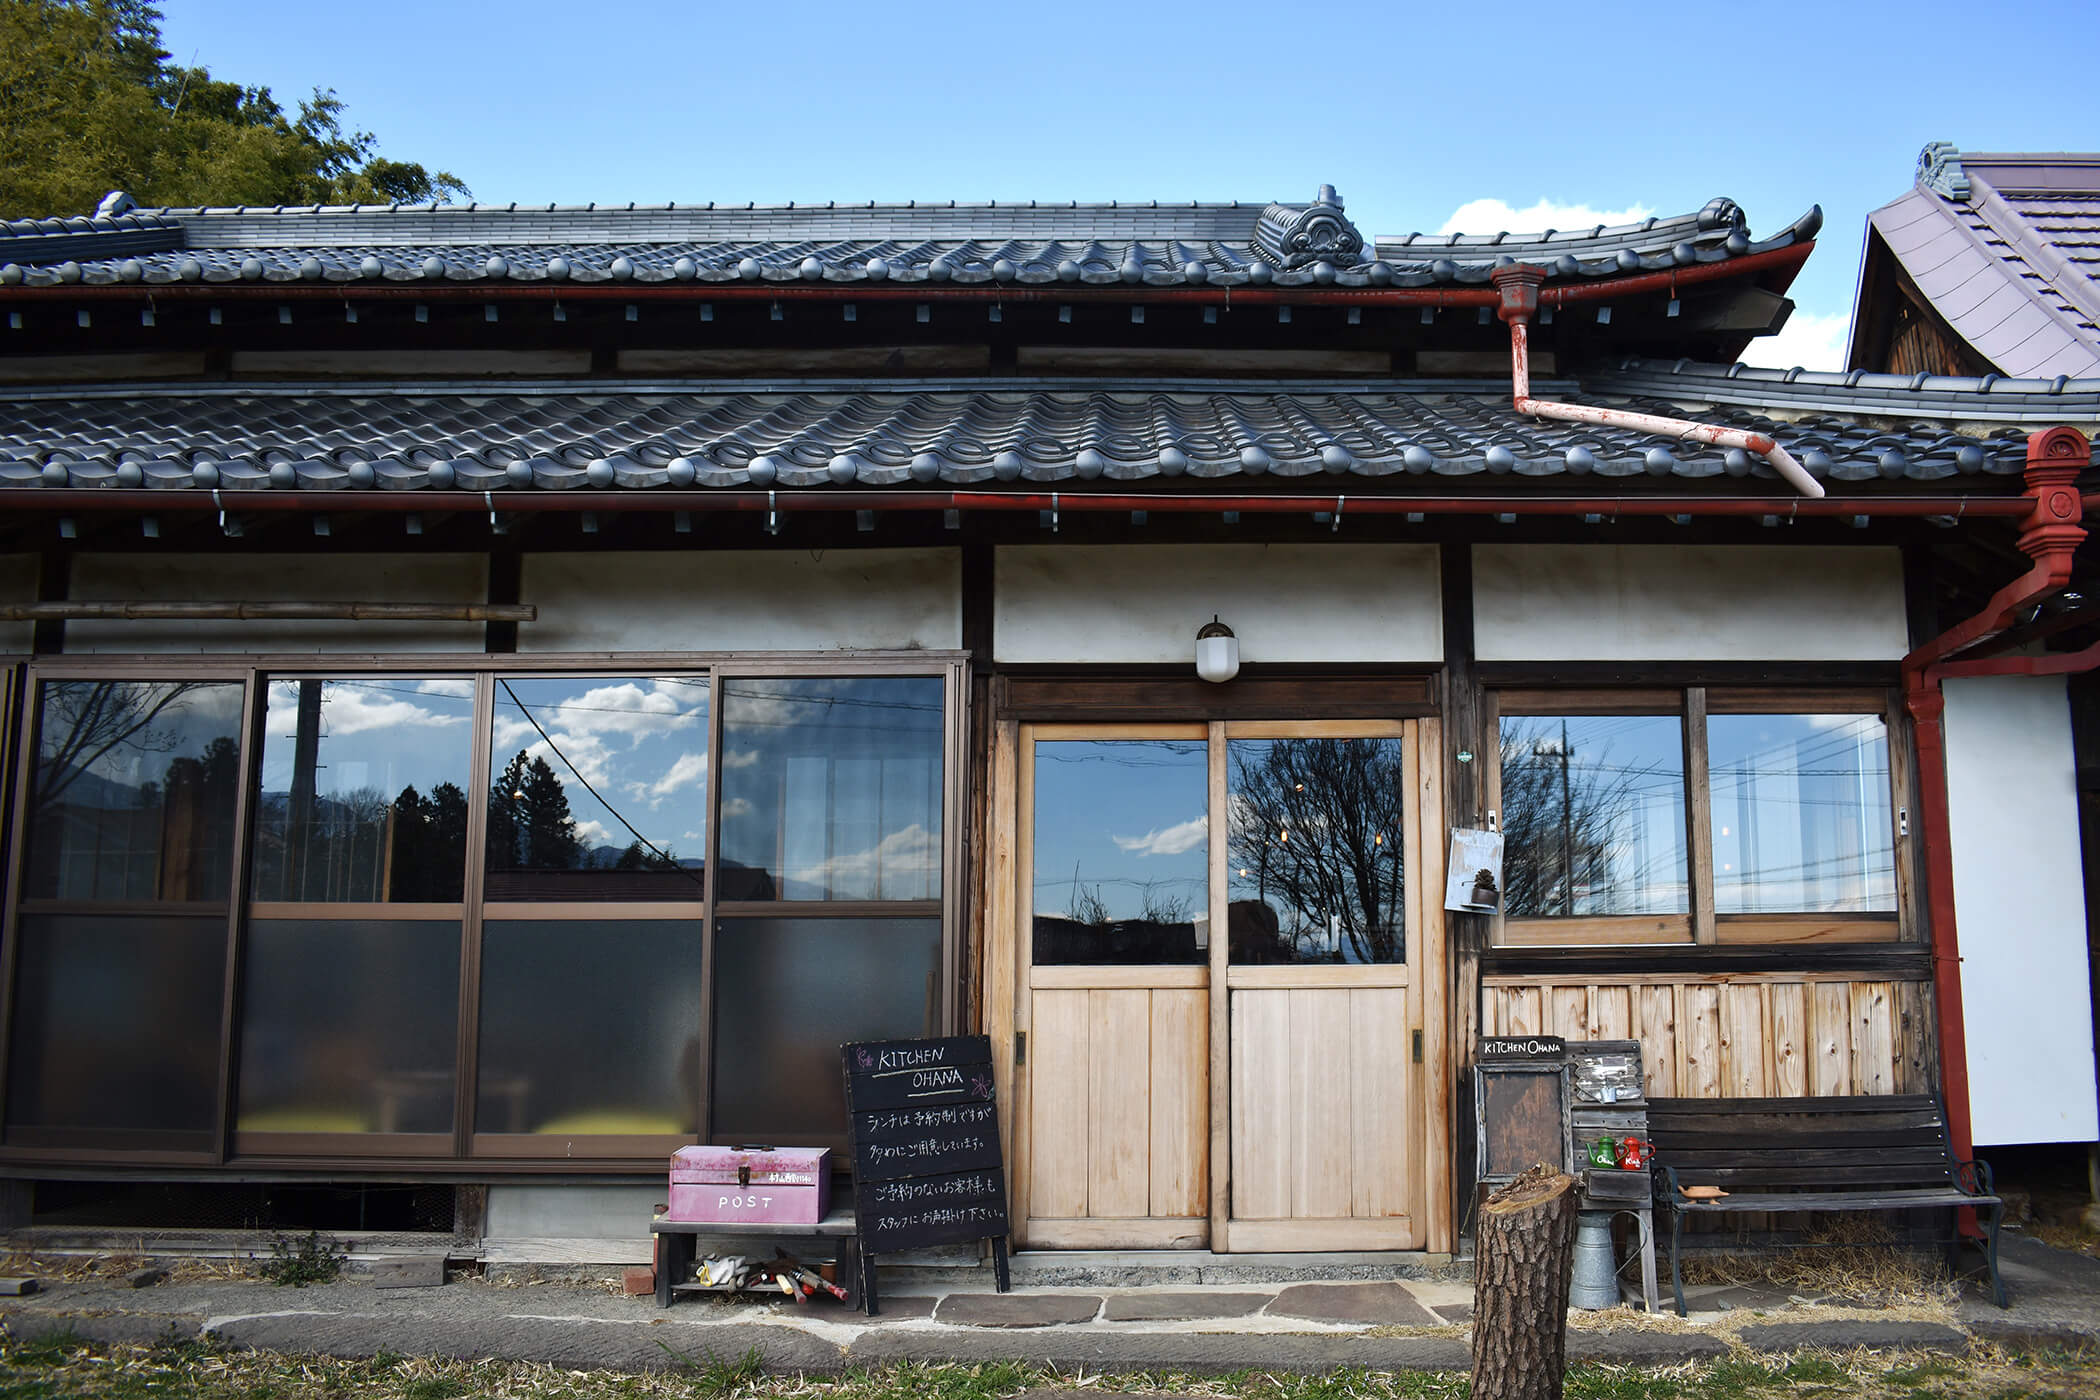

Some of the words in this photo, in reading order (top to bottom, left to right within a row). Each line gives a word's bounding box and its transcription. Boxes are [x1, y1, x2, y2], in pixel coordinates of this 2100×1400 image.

[1484, 1041, 1526, 1054] KITCHEN
[878, 1046, 944, 1071] KITCHEN
[912, 1068, 964, 1088] OHANA
[718, 1195, 773, 1209] POST
